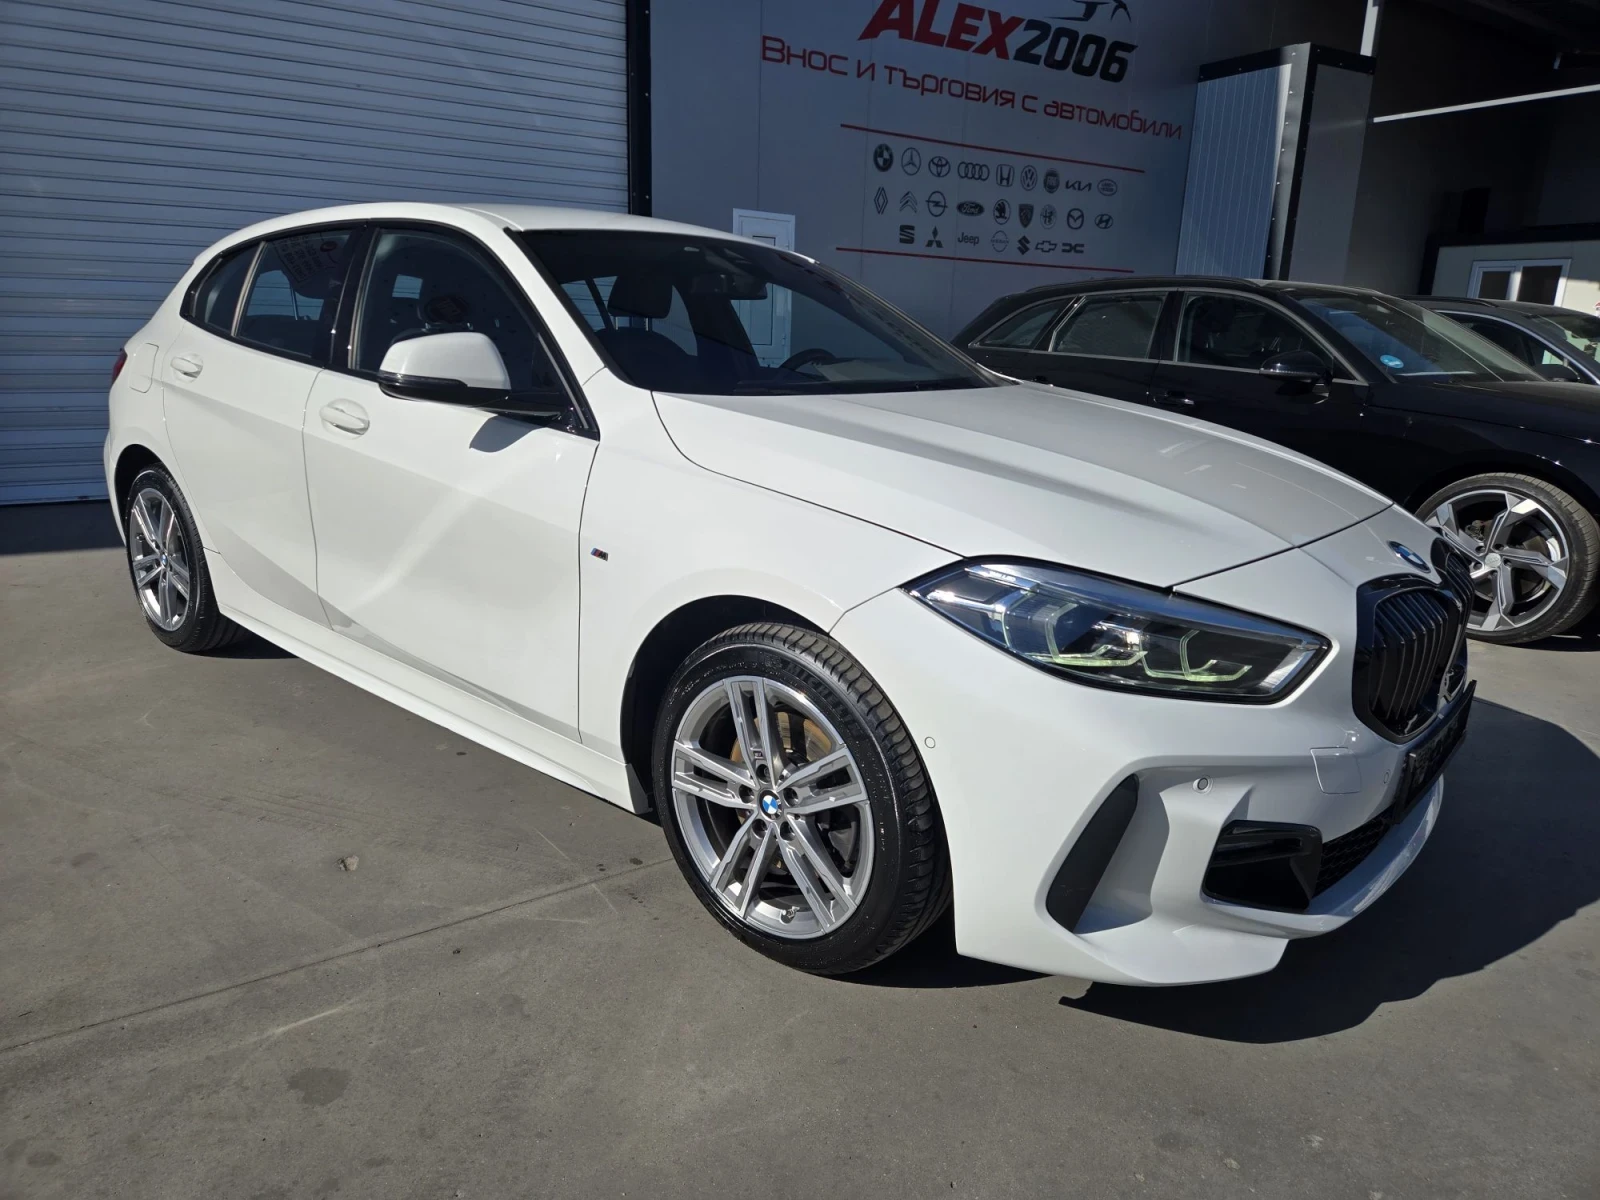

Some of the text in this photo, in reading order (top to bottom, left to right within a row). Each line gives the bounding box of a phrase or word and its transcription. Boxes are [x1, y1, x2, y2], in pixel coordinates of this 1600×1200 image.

[858, 0, 1138, 83] ALEX2006
[762, 35, 848, 76] Внос
[856, 59, 876, 82] и
[884, 65, 1016, 109] търговия
[1043, 101, 1182, 140] автомобили
[960, 202, 981, 214] Ford
[957, 232, 980, 246] Jeep
